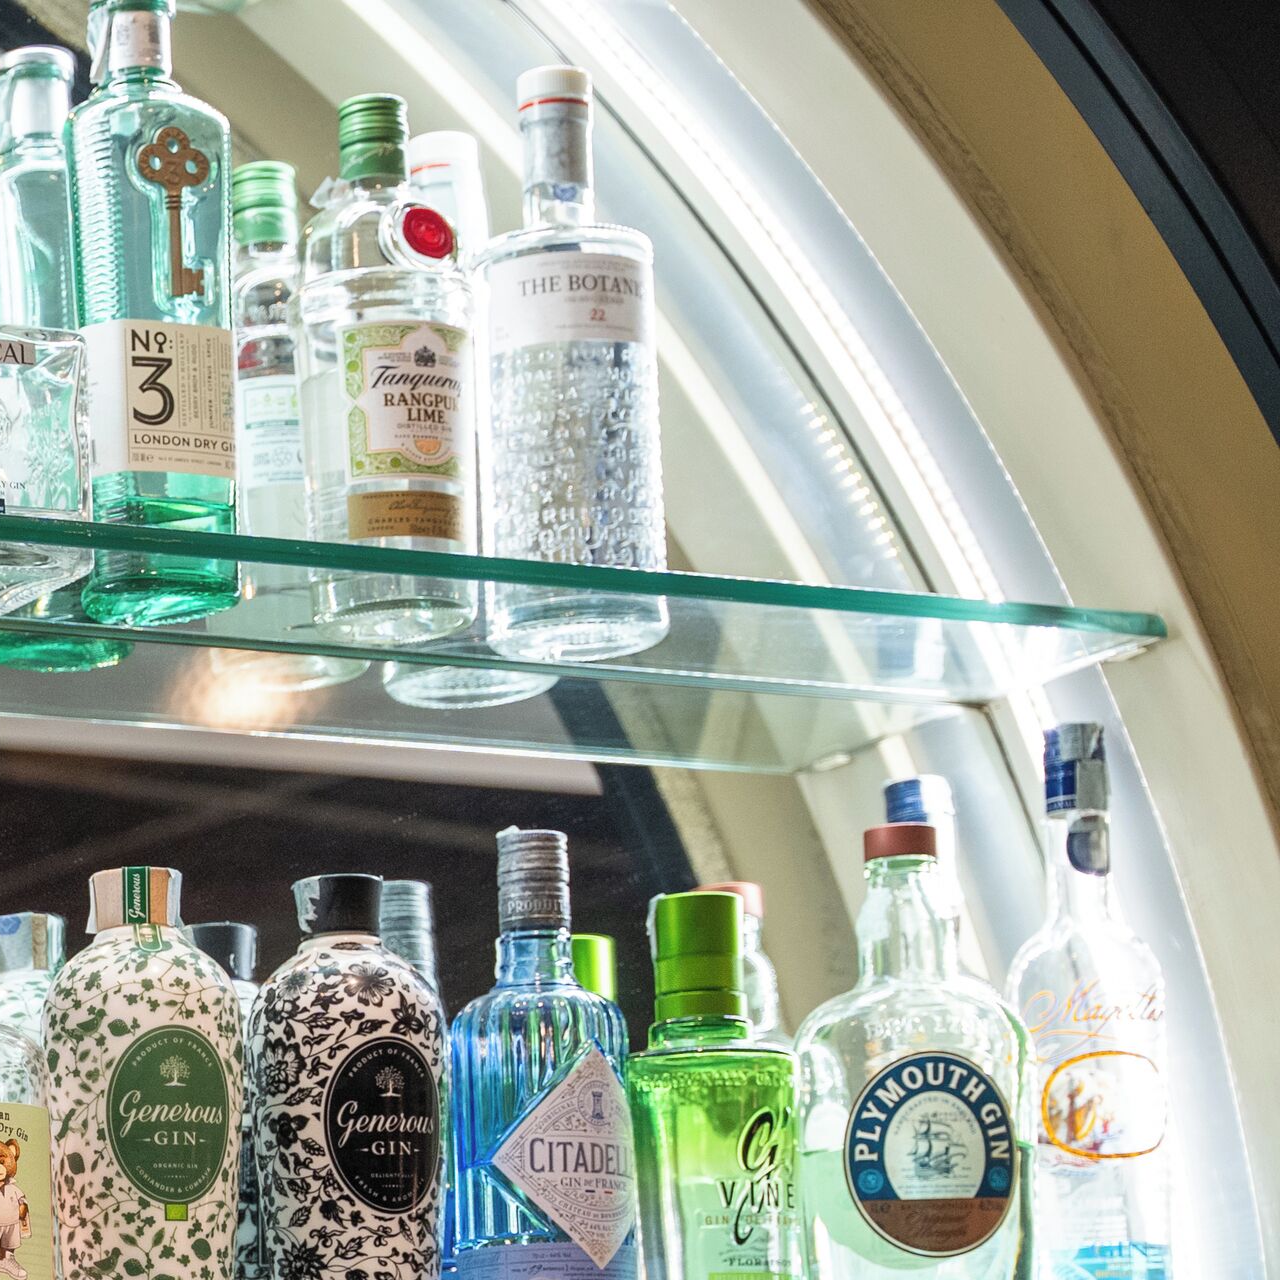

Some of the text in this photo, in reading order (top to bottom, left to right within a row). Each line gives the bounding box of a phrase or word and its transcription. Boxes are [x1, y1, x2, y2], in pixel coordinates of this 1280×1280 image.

[132, 356, 174, 426] 3
[407, 408, 445, 424] LIME
[134, 434, 218, 449] LONDON DRY
[16, 1128, 29, 1142] Gin
[119, 1090, 222, 1138] Generous
[337, 1100, 434, 1148] Generous
[854, 1061, 1011, 1163] PLYMOUTH GIN
